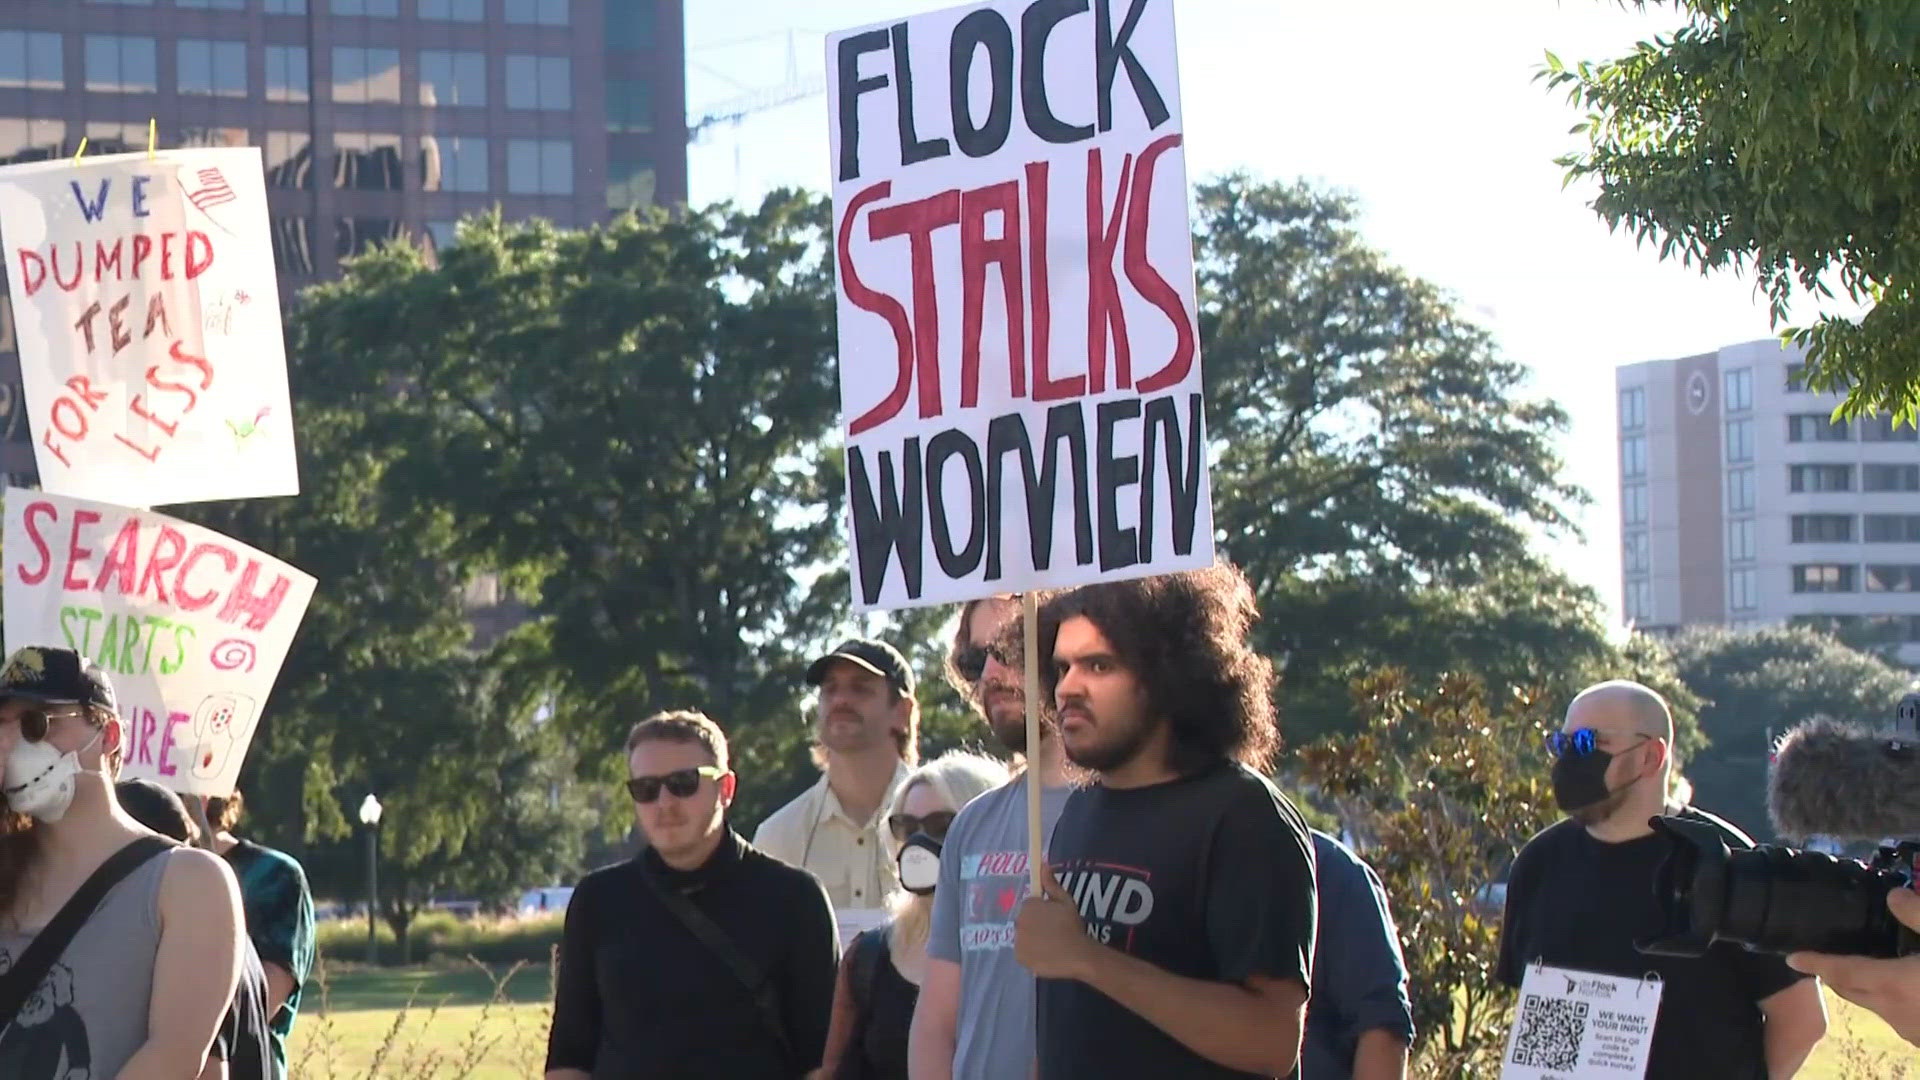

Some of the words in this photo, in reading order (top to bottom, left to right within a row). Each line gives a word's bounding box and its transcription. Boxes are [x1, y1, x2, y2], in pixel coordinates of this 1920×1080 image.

[838, 0, 1170, 182] FLOCK
[71, 175, 151, 224] WE
[18, 230, 214, 298] DUMPED
[838, 133, 1195, 436] STALKS
[75, 291, 173, 358] TEA
[43, 374, 109, 468] FOR
[113, 339, 214, 463] LESS
[848, 393, 1201, 605] WOMEN
[17, 501, 292, 632] SEARCH
[59, 606, 196, 675] STARTS
[1592, 1019, 1618, 1031] YOUR
[1620, 1023, 1648, 1035] INPUT
[1599, 1010, 1613, 1020] WE
[1617, 1013, 1646, 1025] WANT
